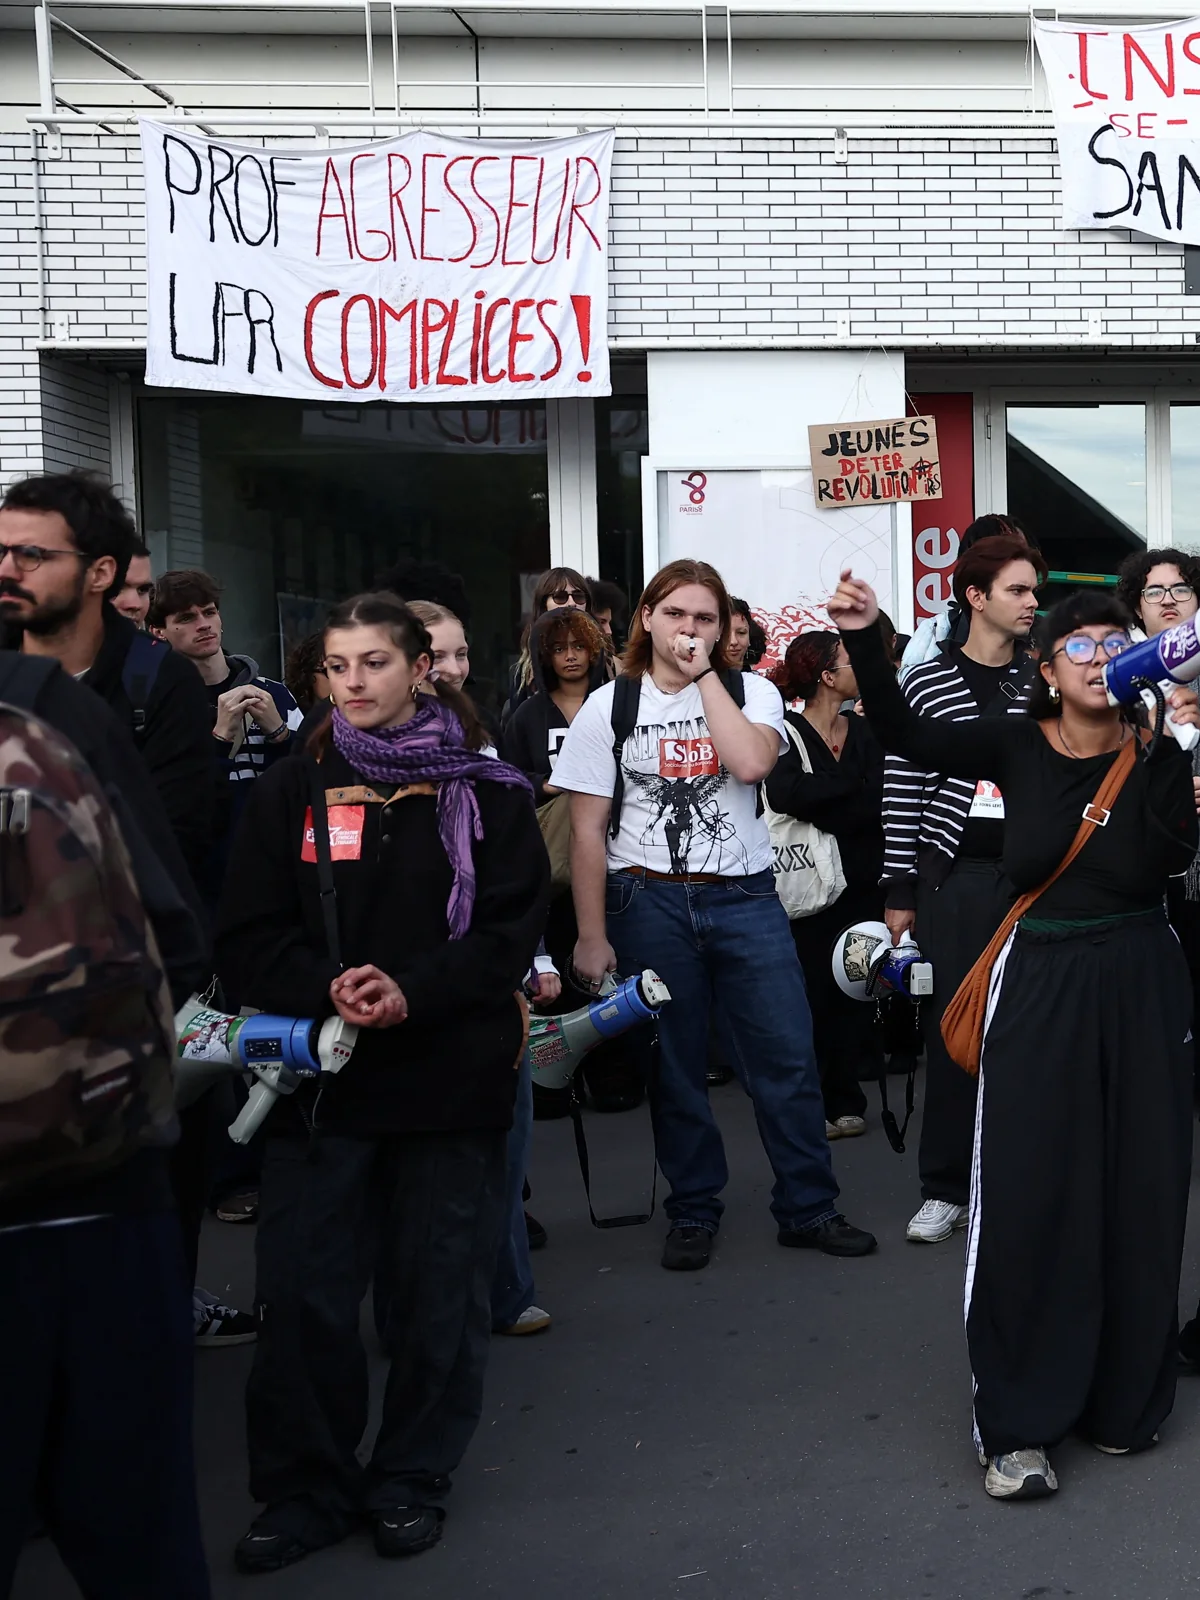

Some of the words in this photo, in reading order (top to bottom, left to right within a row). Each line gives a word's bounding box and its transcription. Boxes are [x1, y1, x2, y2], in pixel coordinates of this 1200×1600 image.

[163, 134, 302, 248] PROF
[316, 153, 602, 268] AGRESSEUR
[821, 418, 930, 457] JEUNES
[838, 452, 905, 477] DETER
